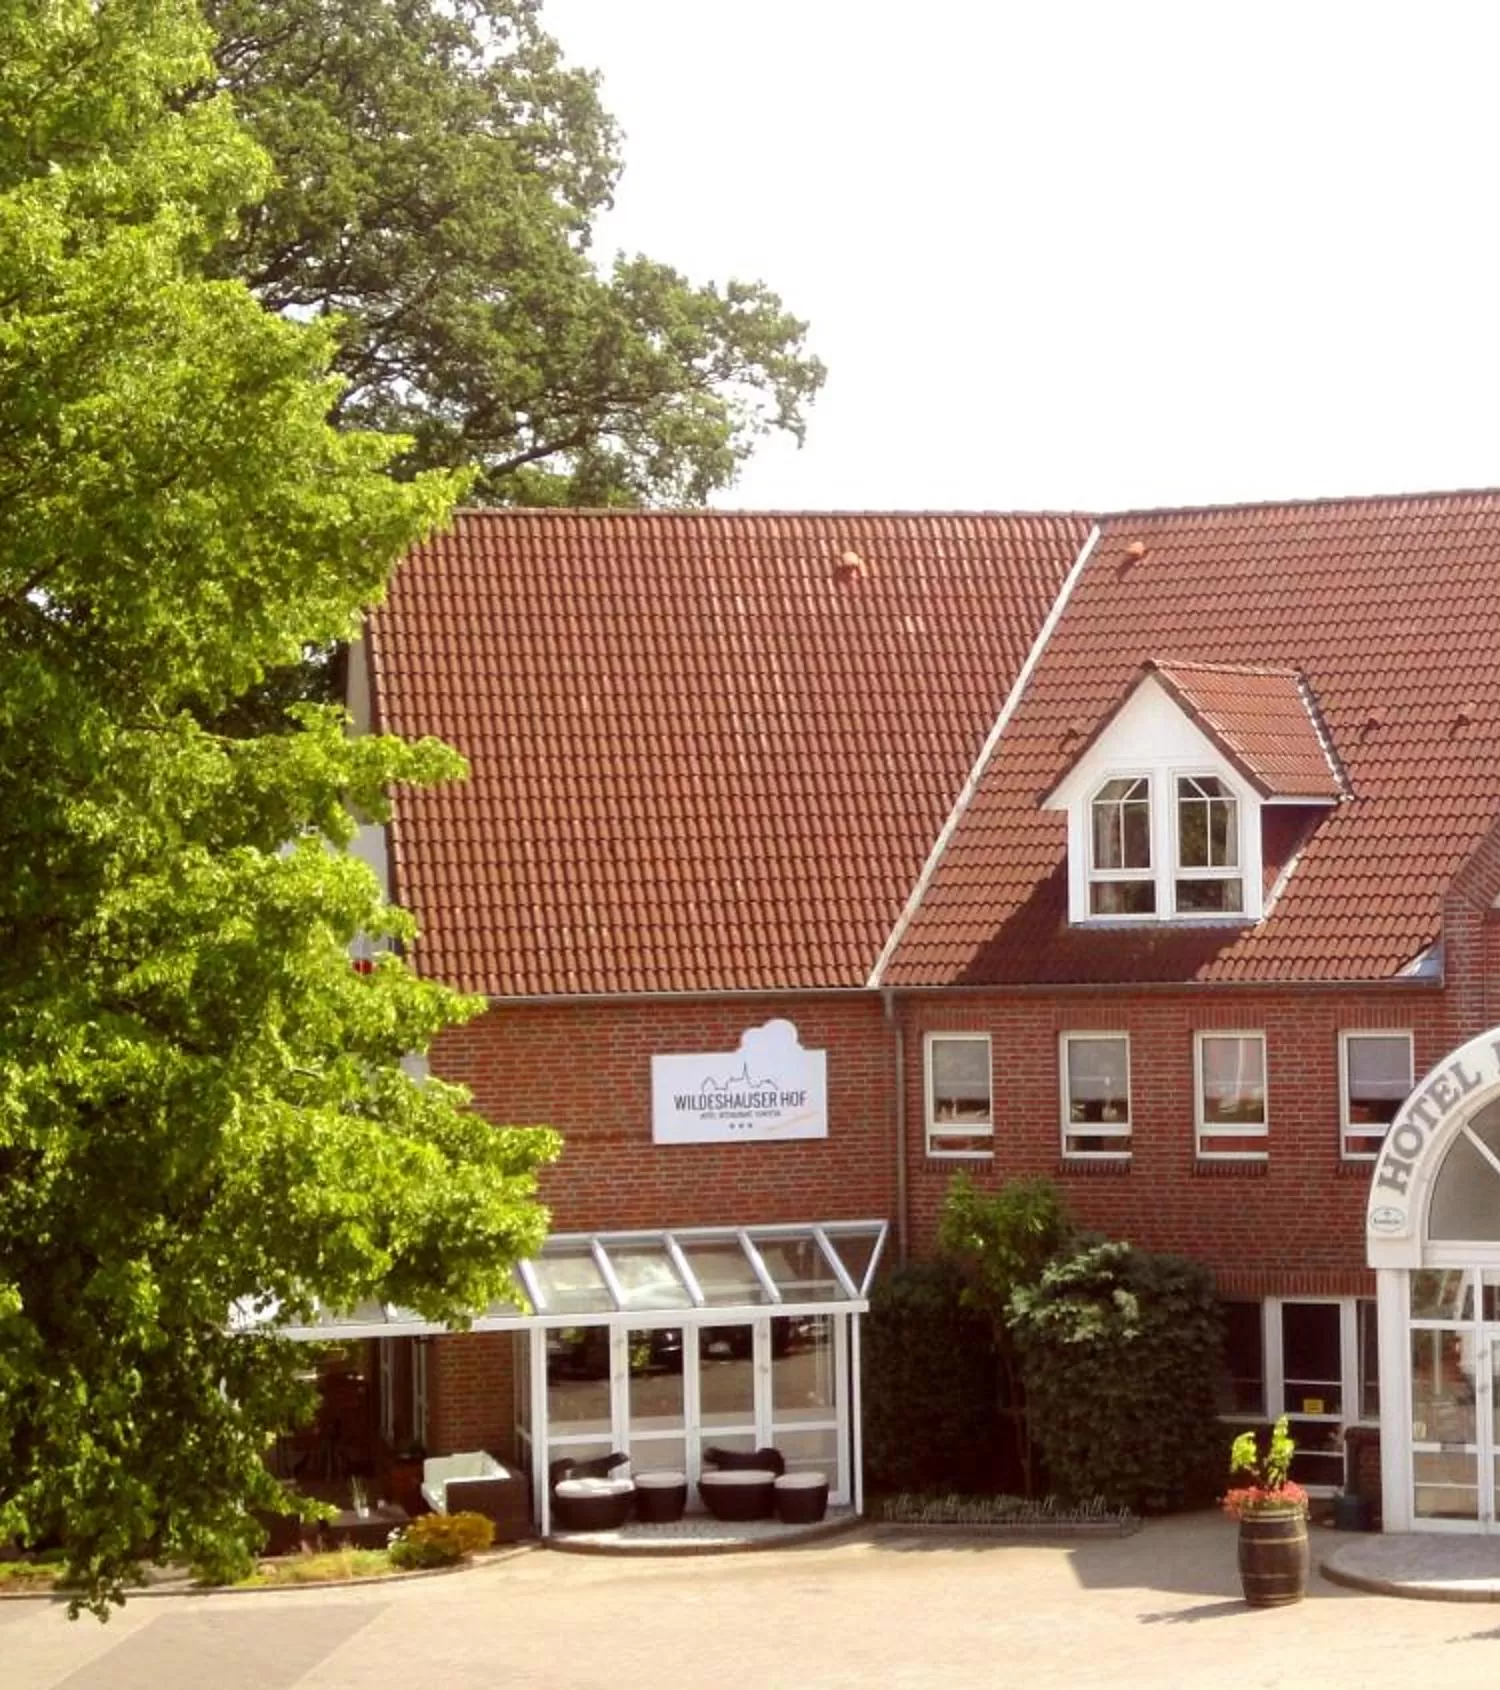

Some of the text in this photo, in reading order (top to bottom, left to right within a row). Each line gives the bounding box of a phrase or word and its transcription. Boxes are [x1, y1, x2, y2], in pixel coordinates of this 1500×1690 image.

[674, 1090, 807, 1111] WILDESHAUSER HOF
[1378, 1061, 1481, 1195] HOTEL
